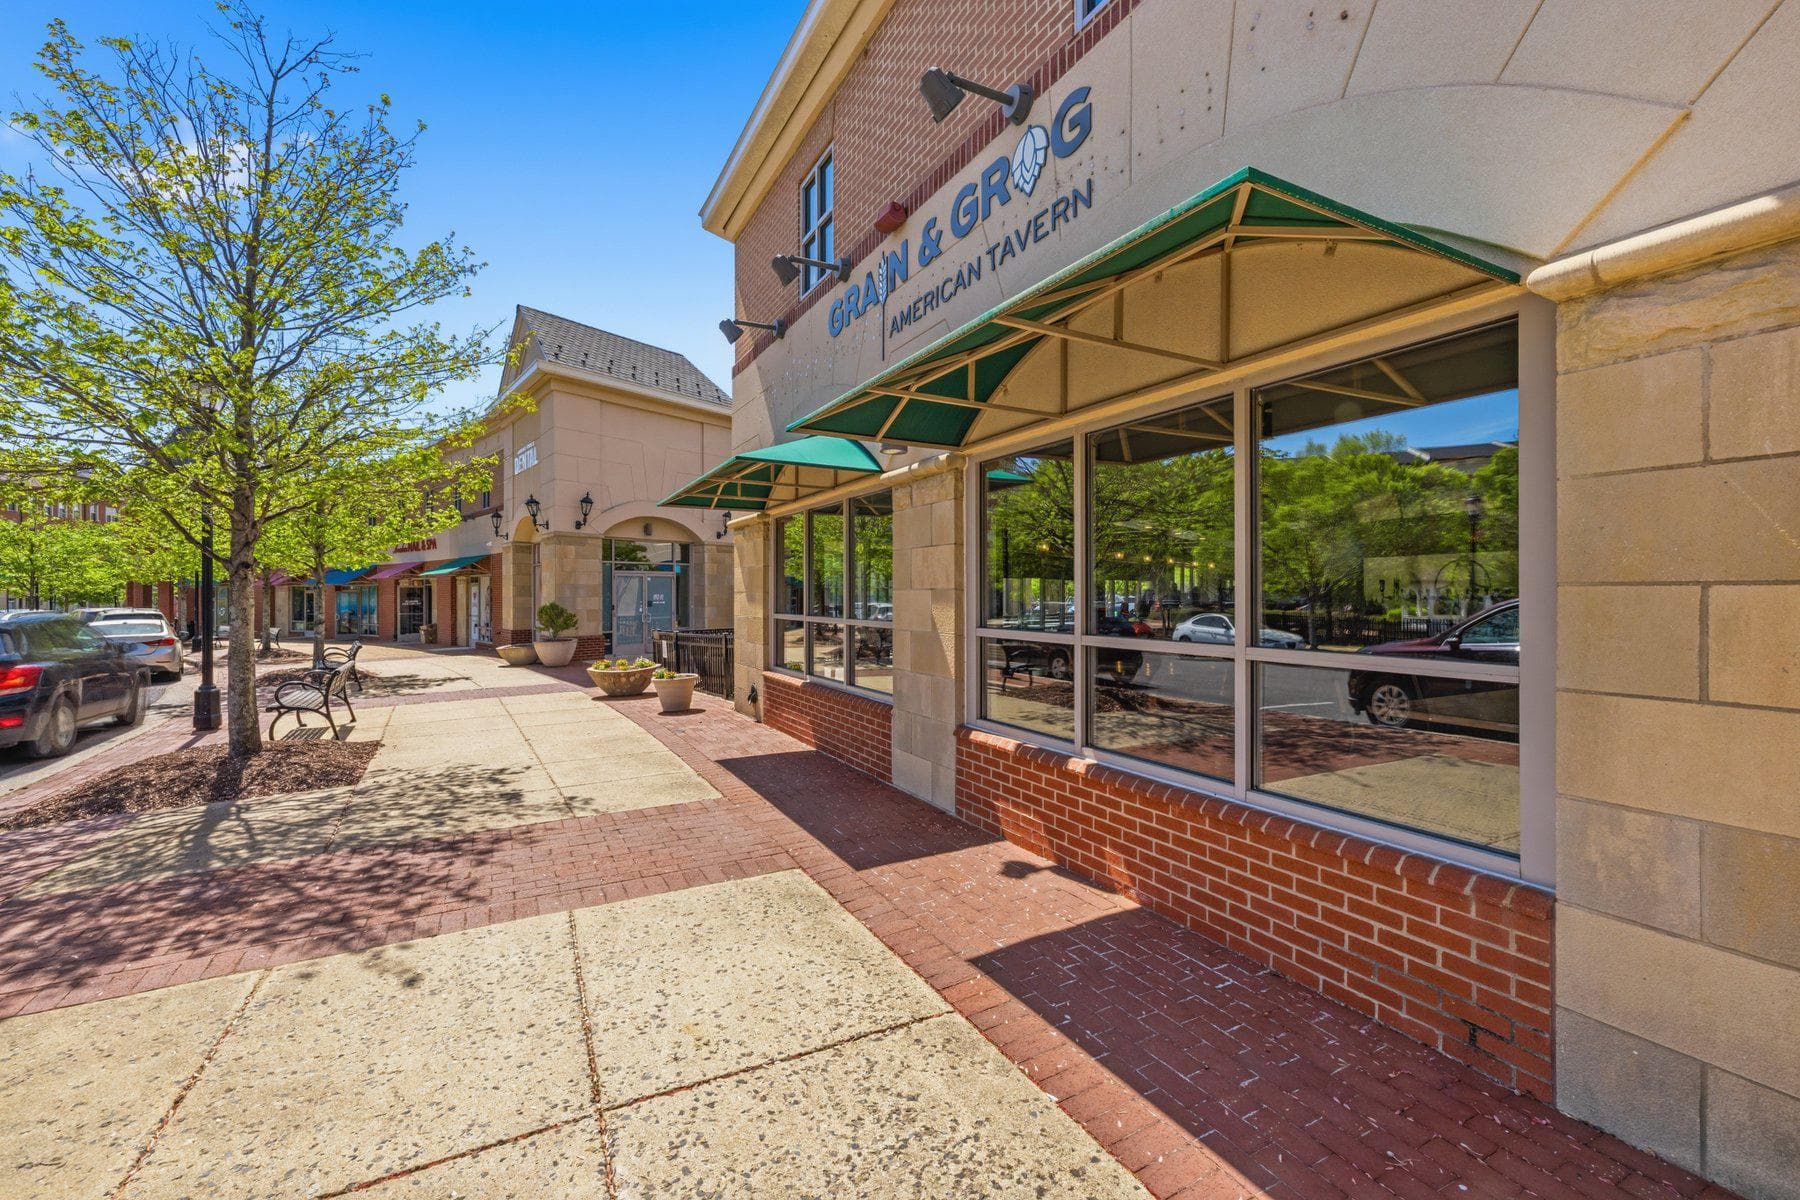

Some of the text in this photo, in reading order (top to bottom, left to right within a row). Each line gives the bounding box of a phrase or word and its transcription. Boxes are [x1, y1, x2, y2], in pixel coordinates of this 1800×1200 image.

[828, 239, 909, 337] GRAIN
[918, 217, 943, 267] &
[889, 178, 1094, 338] AMERICAN TAVERN
[514, 446, 538, 475] DENTAL
